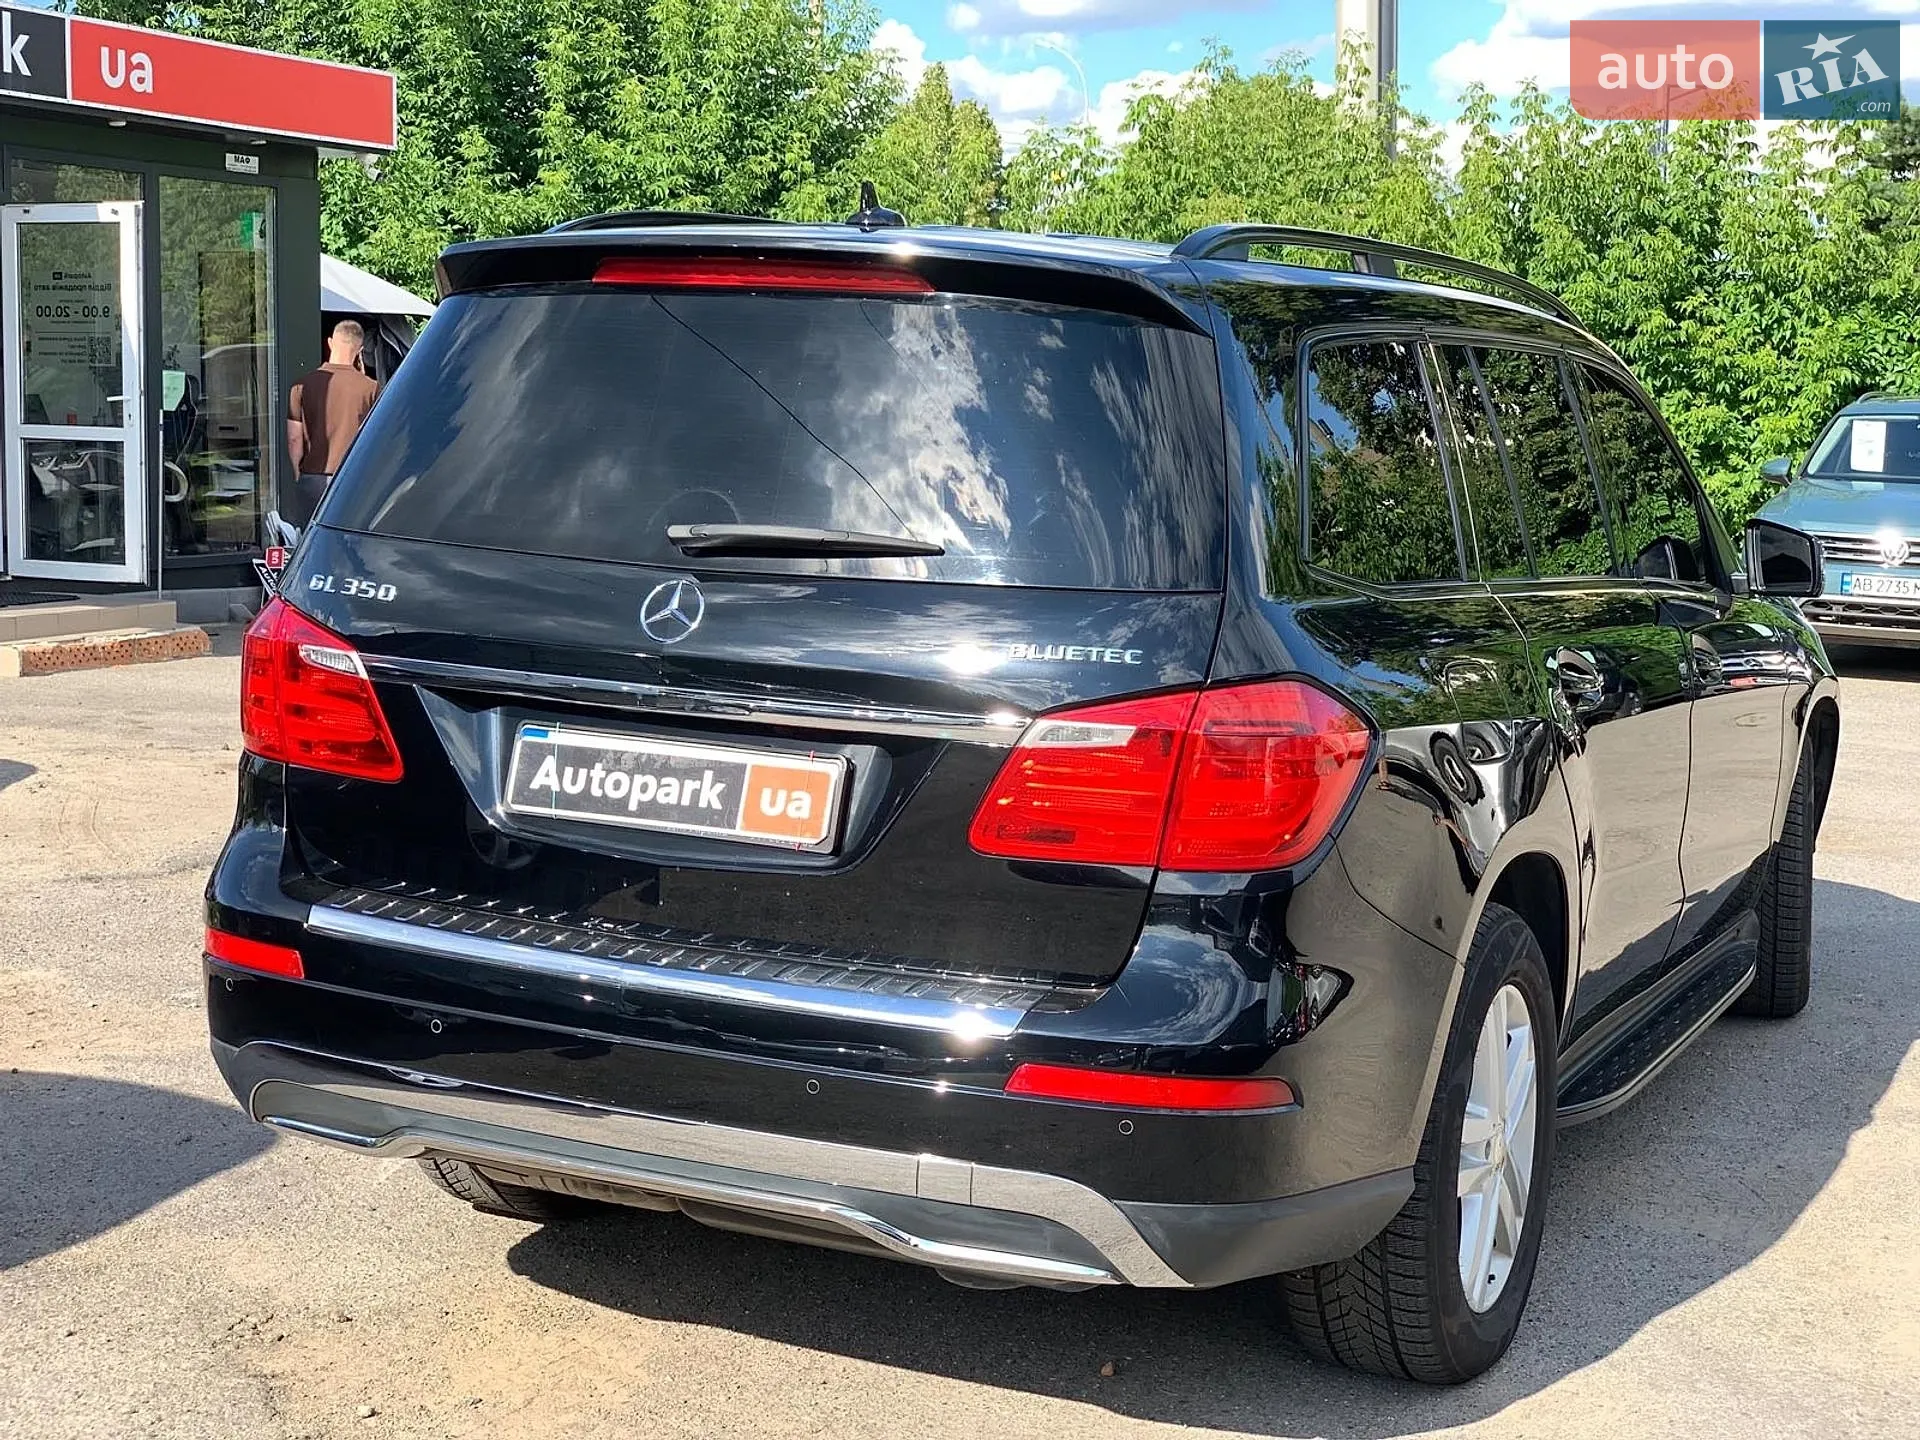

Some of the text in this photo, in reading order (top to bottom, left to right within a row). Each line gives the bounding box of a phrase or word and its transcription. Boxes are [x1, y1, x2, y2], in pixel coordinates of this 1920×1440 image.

[100, 46, 154, 94] ua
[309, 574, 397, 602] GL 350
[1853, 577, 1873, 592] AB
[1876, 579, 1910, 595] 2735
[1008, 643, 1144, 665] BLUETEC
[530, 754, 812, 819] Autopark ua
